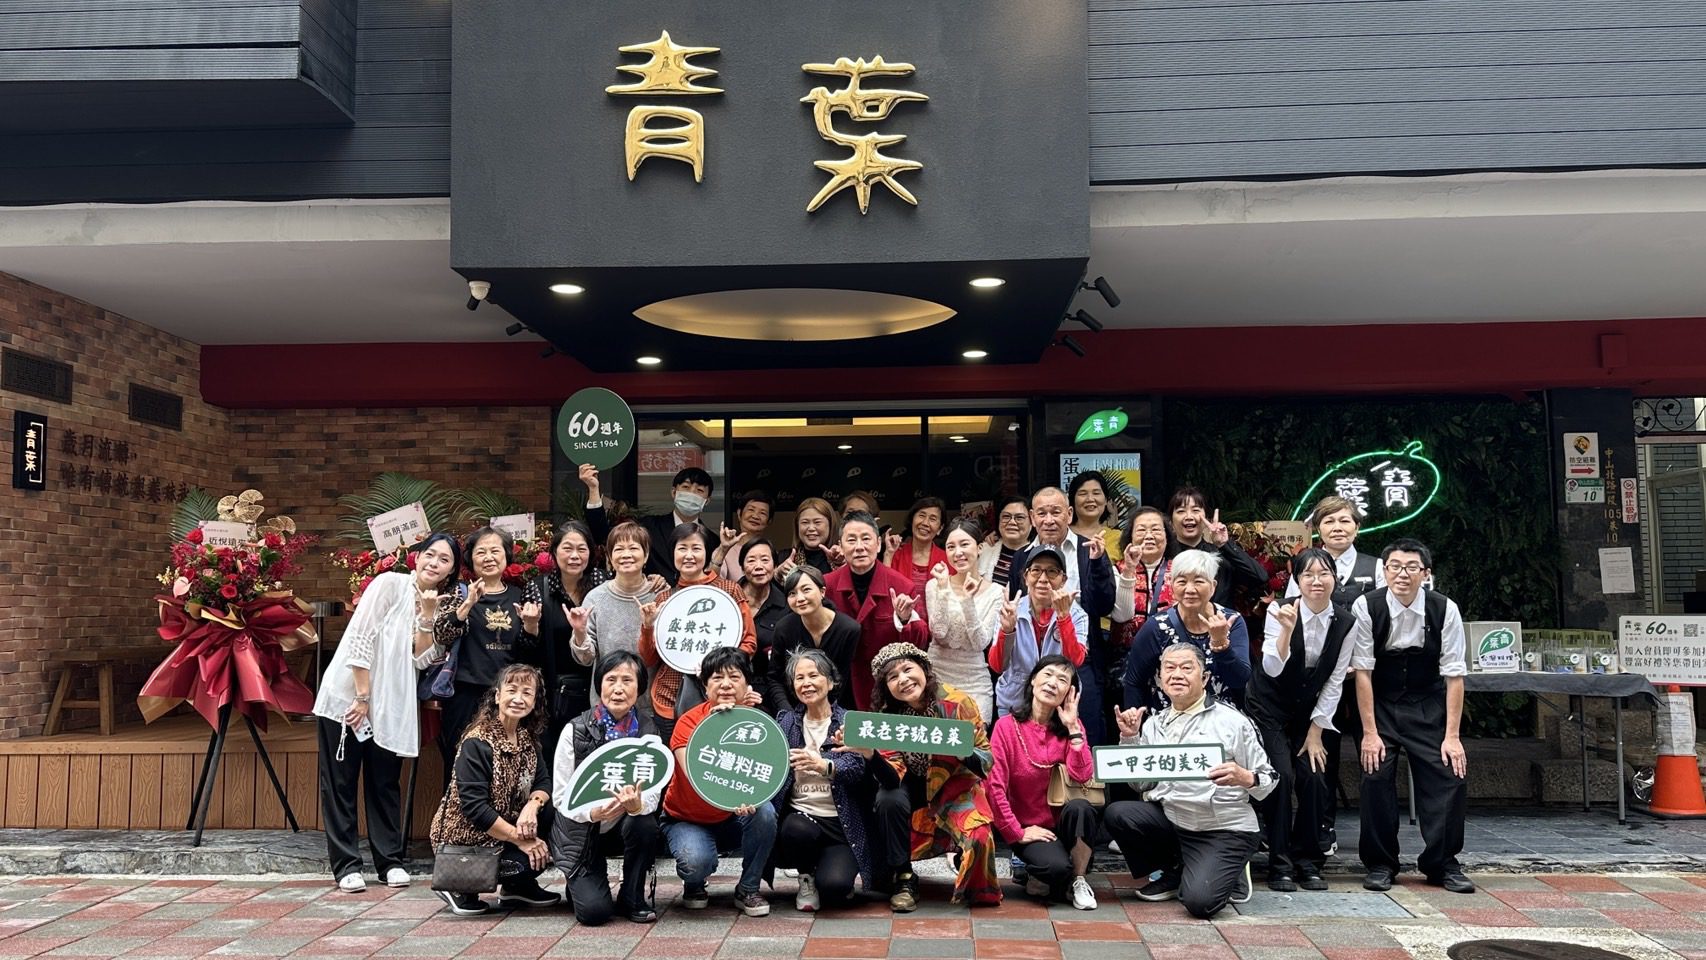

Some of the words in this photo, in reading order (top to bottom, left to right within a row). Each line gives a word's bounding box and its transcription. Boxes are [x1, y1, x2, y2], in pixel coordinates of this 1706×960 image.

[605, 29, 930, 215] 青葉
[568, 411, 623, 438] 60週年
[573, 441, 598, 450] SINCE
[600, 439, 619, 448] 1964
[1583, 491, 1597, 501] 10
[383, 519, 419, 539] 高朋滿座
[667, 617, 727, 637] 盛典六十
[858, 719, 963, 747] 最老字號台菜
[698, 744, 773, 783] 台灣料理
[1106, 752, 1213, 773] 一甲子的美味
[702, 770, 729, 787] Since
[730, 778, 755, 795] 1964
